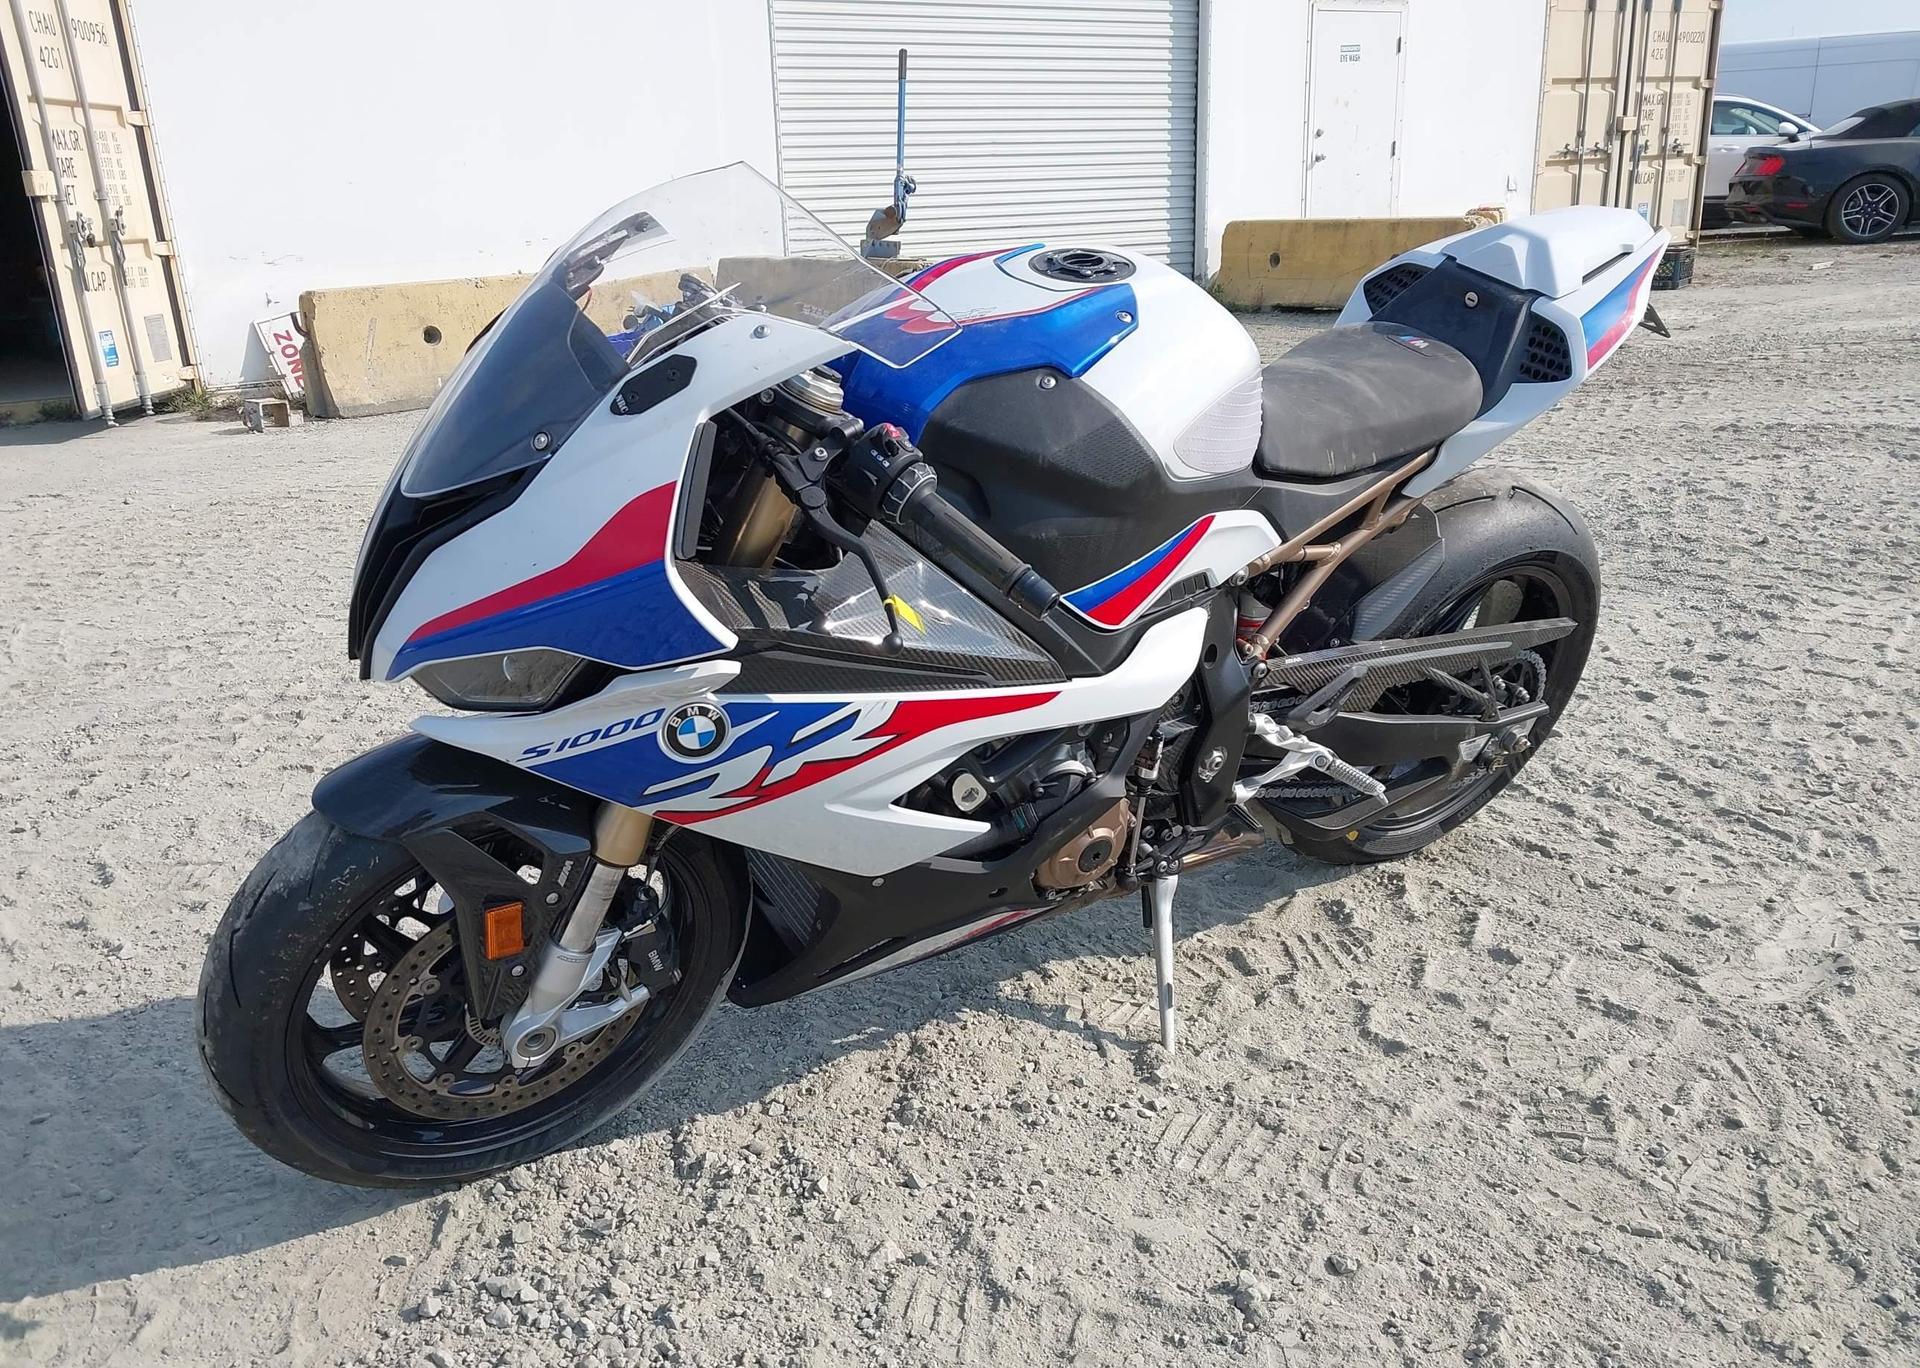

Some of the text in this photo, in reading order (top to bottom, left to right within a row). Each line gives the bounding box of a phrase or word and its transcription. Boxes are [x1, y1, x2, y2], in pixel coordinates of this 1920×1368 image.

[28, 10, 56, 36] CHAU
[56, 157, 77, 178] TARE
[515, 707, 667, 763] S1000
[647, 949, 664, 973] BMW
